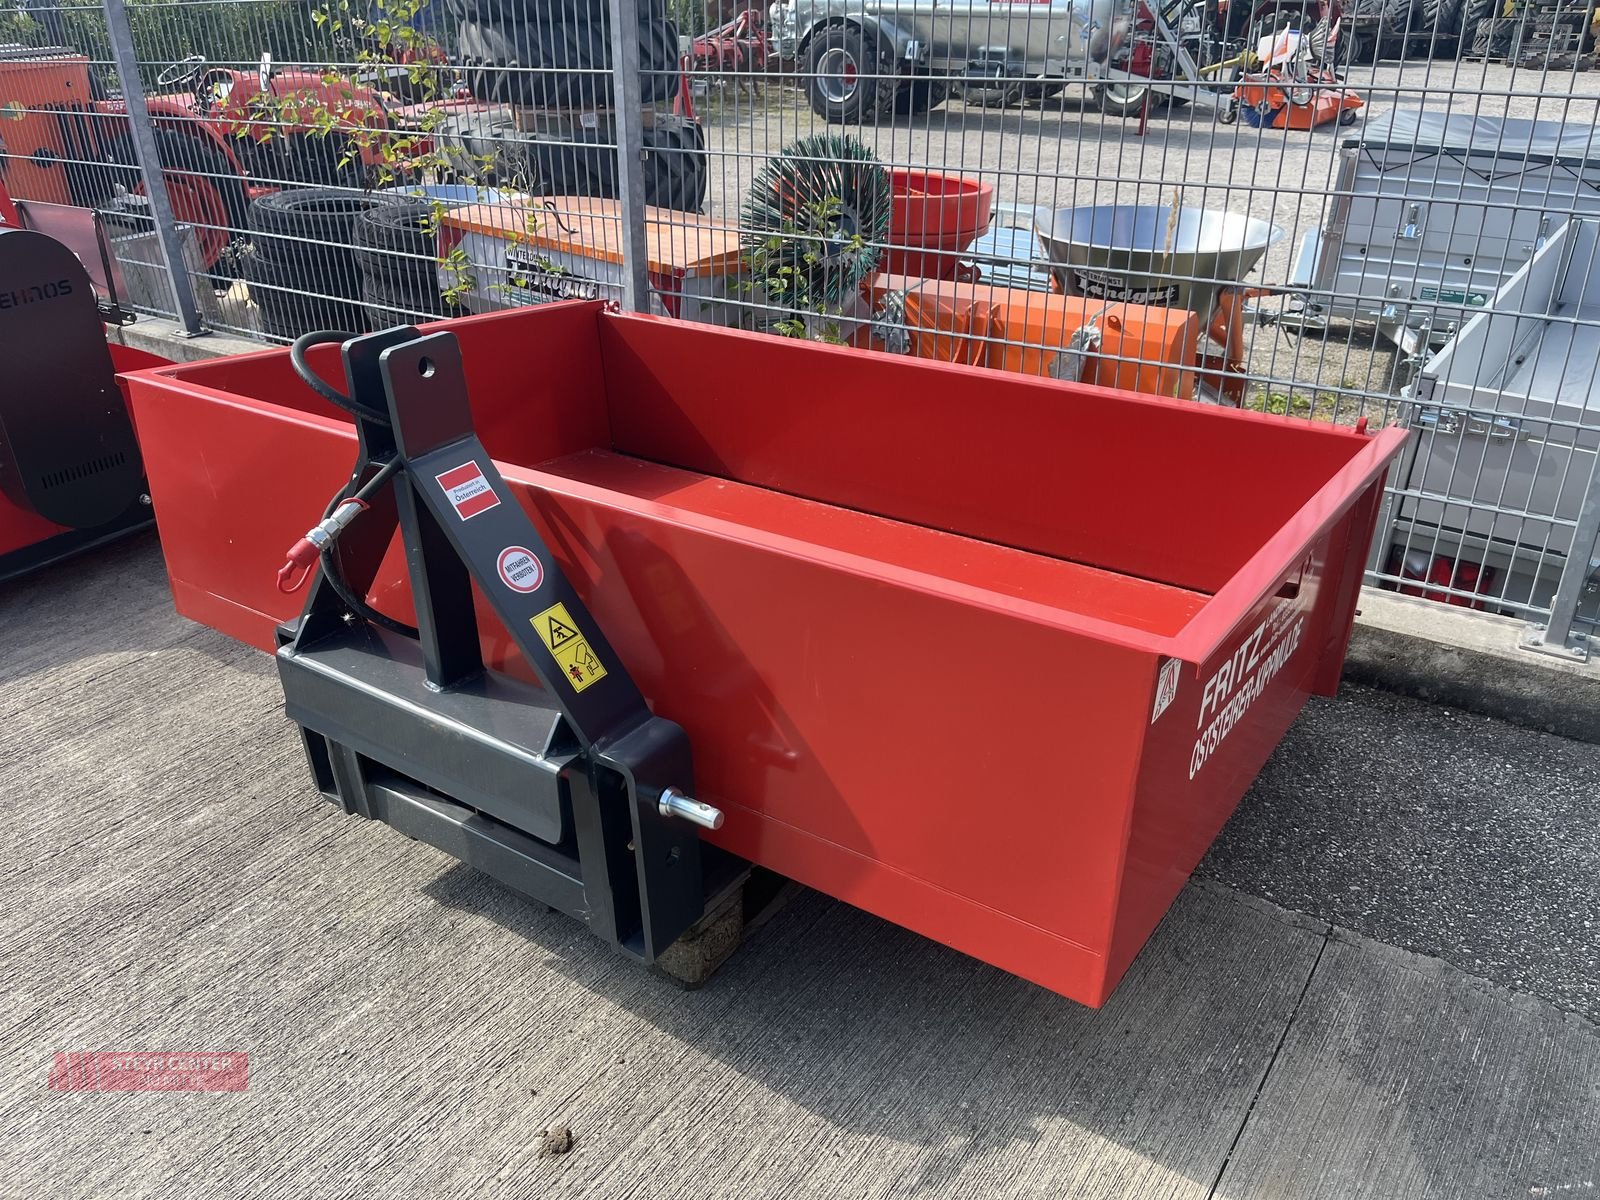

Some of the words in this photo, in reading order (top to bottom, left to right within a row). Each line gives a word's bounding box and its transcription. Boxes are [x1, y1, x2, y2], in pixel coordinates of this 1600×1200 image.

[1078, 277, 1176, 304] Landgut
[455, 484, 487, 502] Österreich
[505, 555, 531, 573] MITFAHREN
[1197, 620, 1267, 731] FRITZ
